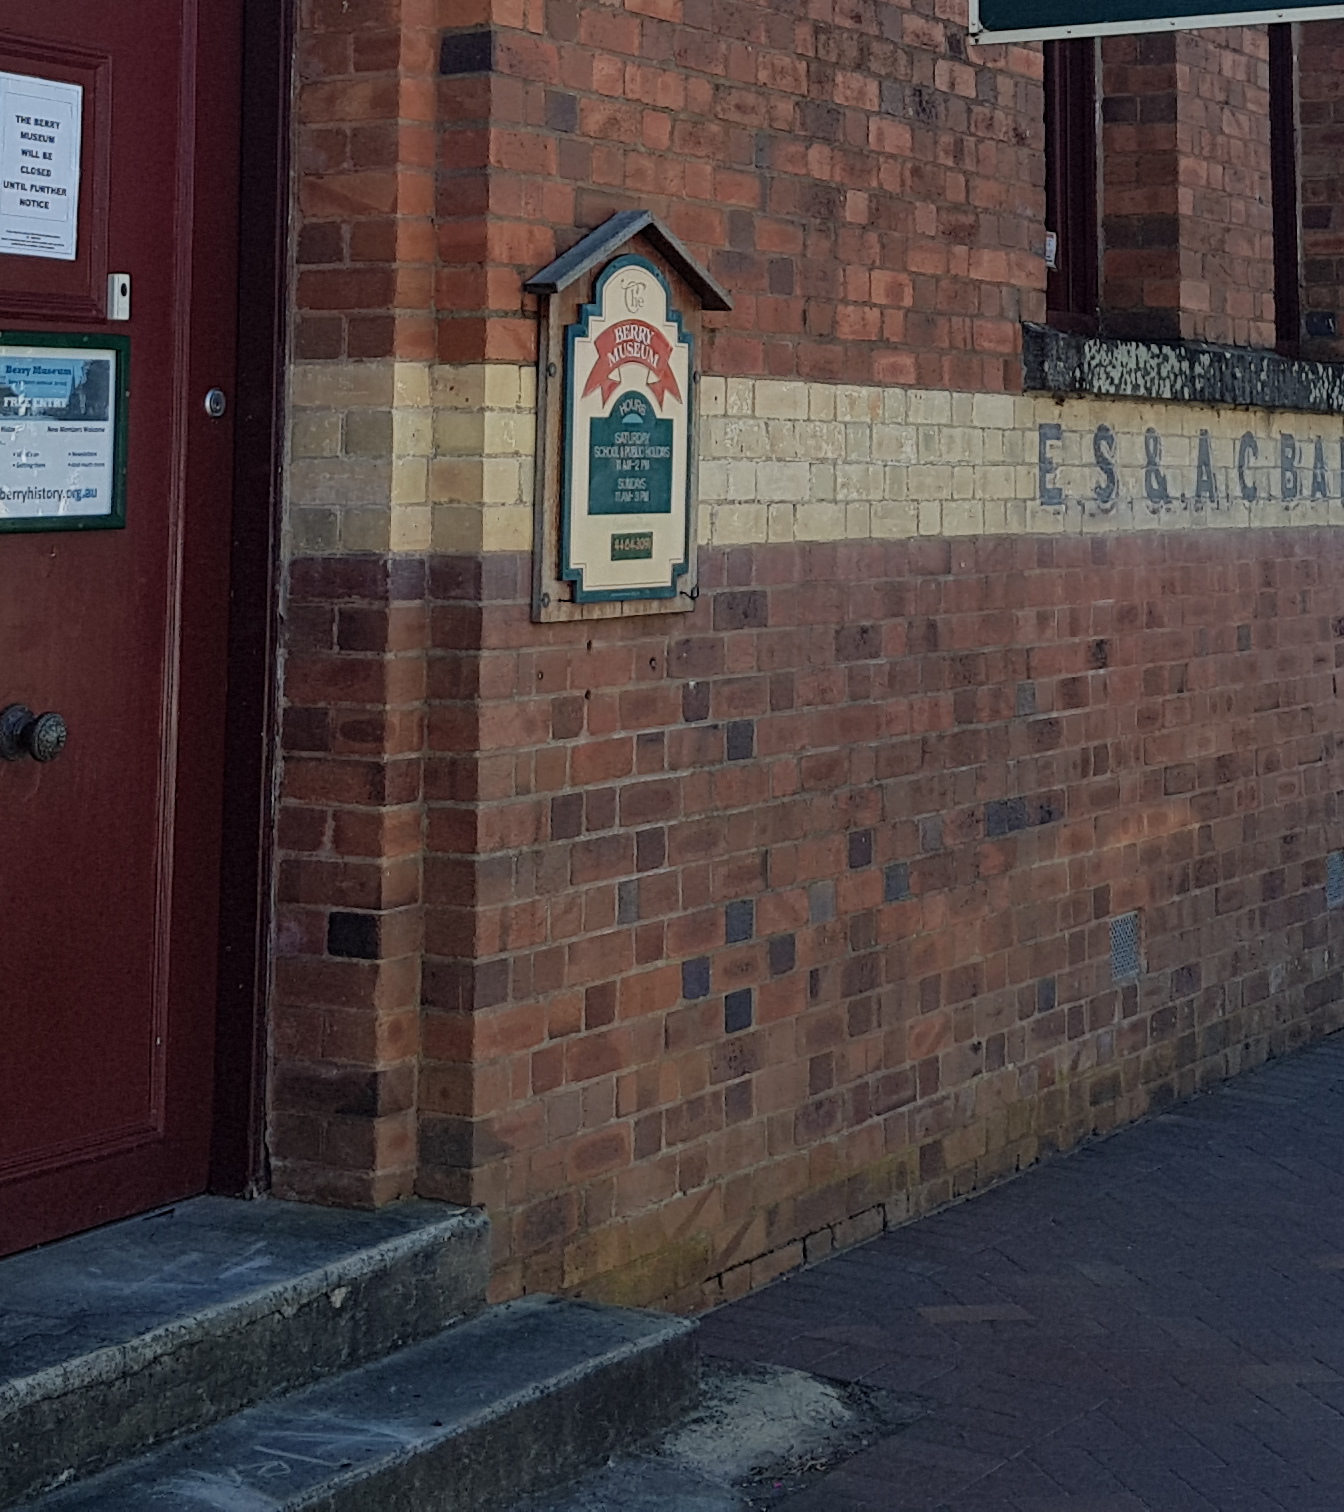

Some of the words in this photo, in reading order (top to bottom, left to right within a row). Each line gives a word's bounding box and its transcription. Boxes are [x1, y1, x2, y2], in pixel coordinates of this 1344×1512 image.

[15, 114, 31, 125] THE
[34, 118, 61, 129] BERRY
[20, 131, 55, 144] MUSEUM
[21, 148, 40, 159] WILL
[43, 152, 52, 160] BE
[20, 166, 51, 177] CLOSED
[3, 180, 27, 192] UNTIL
[30, 184, 67, 196] FURTHER
[20, 198, 49, 209] NOTICE
[620, 278, 646, 314] The
[614, 324, 654, 345] BERRY
[607, 341, 660, 368] MUSEUM
[6, 365, 31, 376] Berry
[32, 366, 71, 375] Museum
[619, 398, 646, 416] HOURS
[594, 446, 619, 458] SCHOOL
